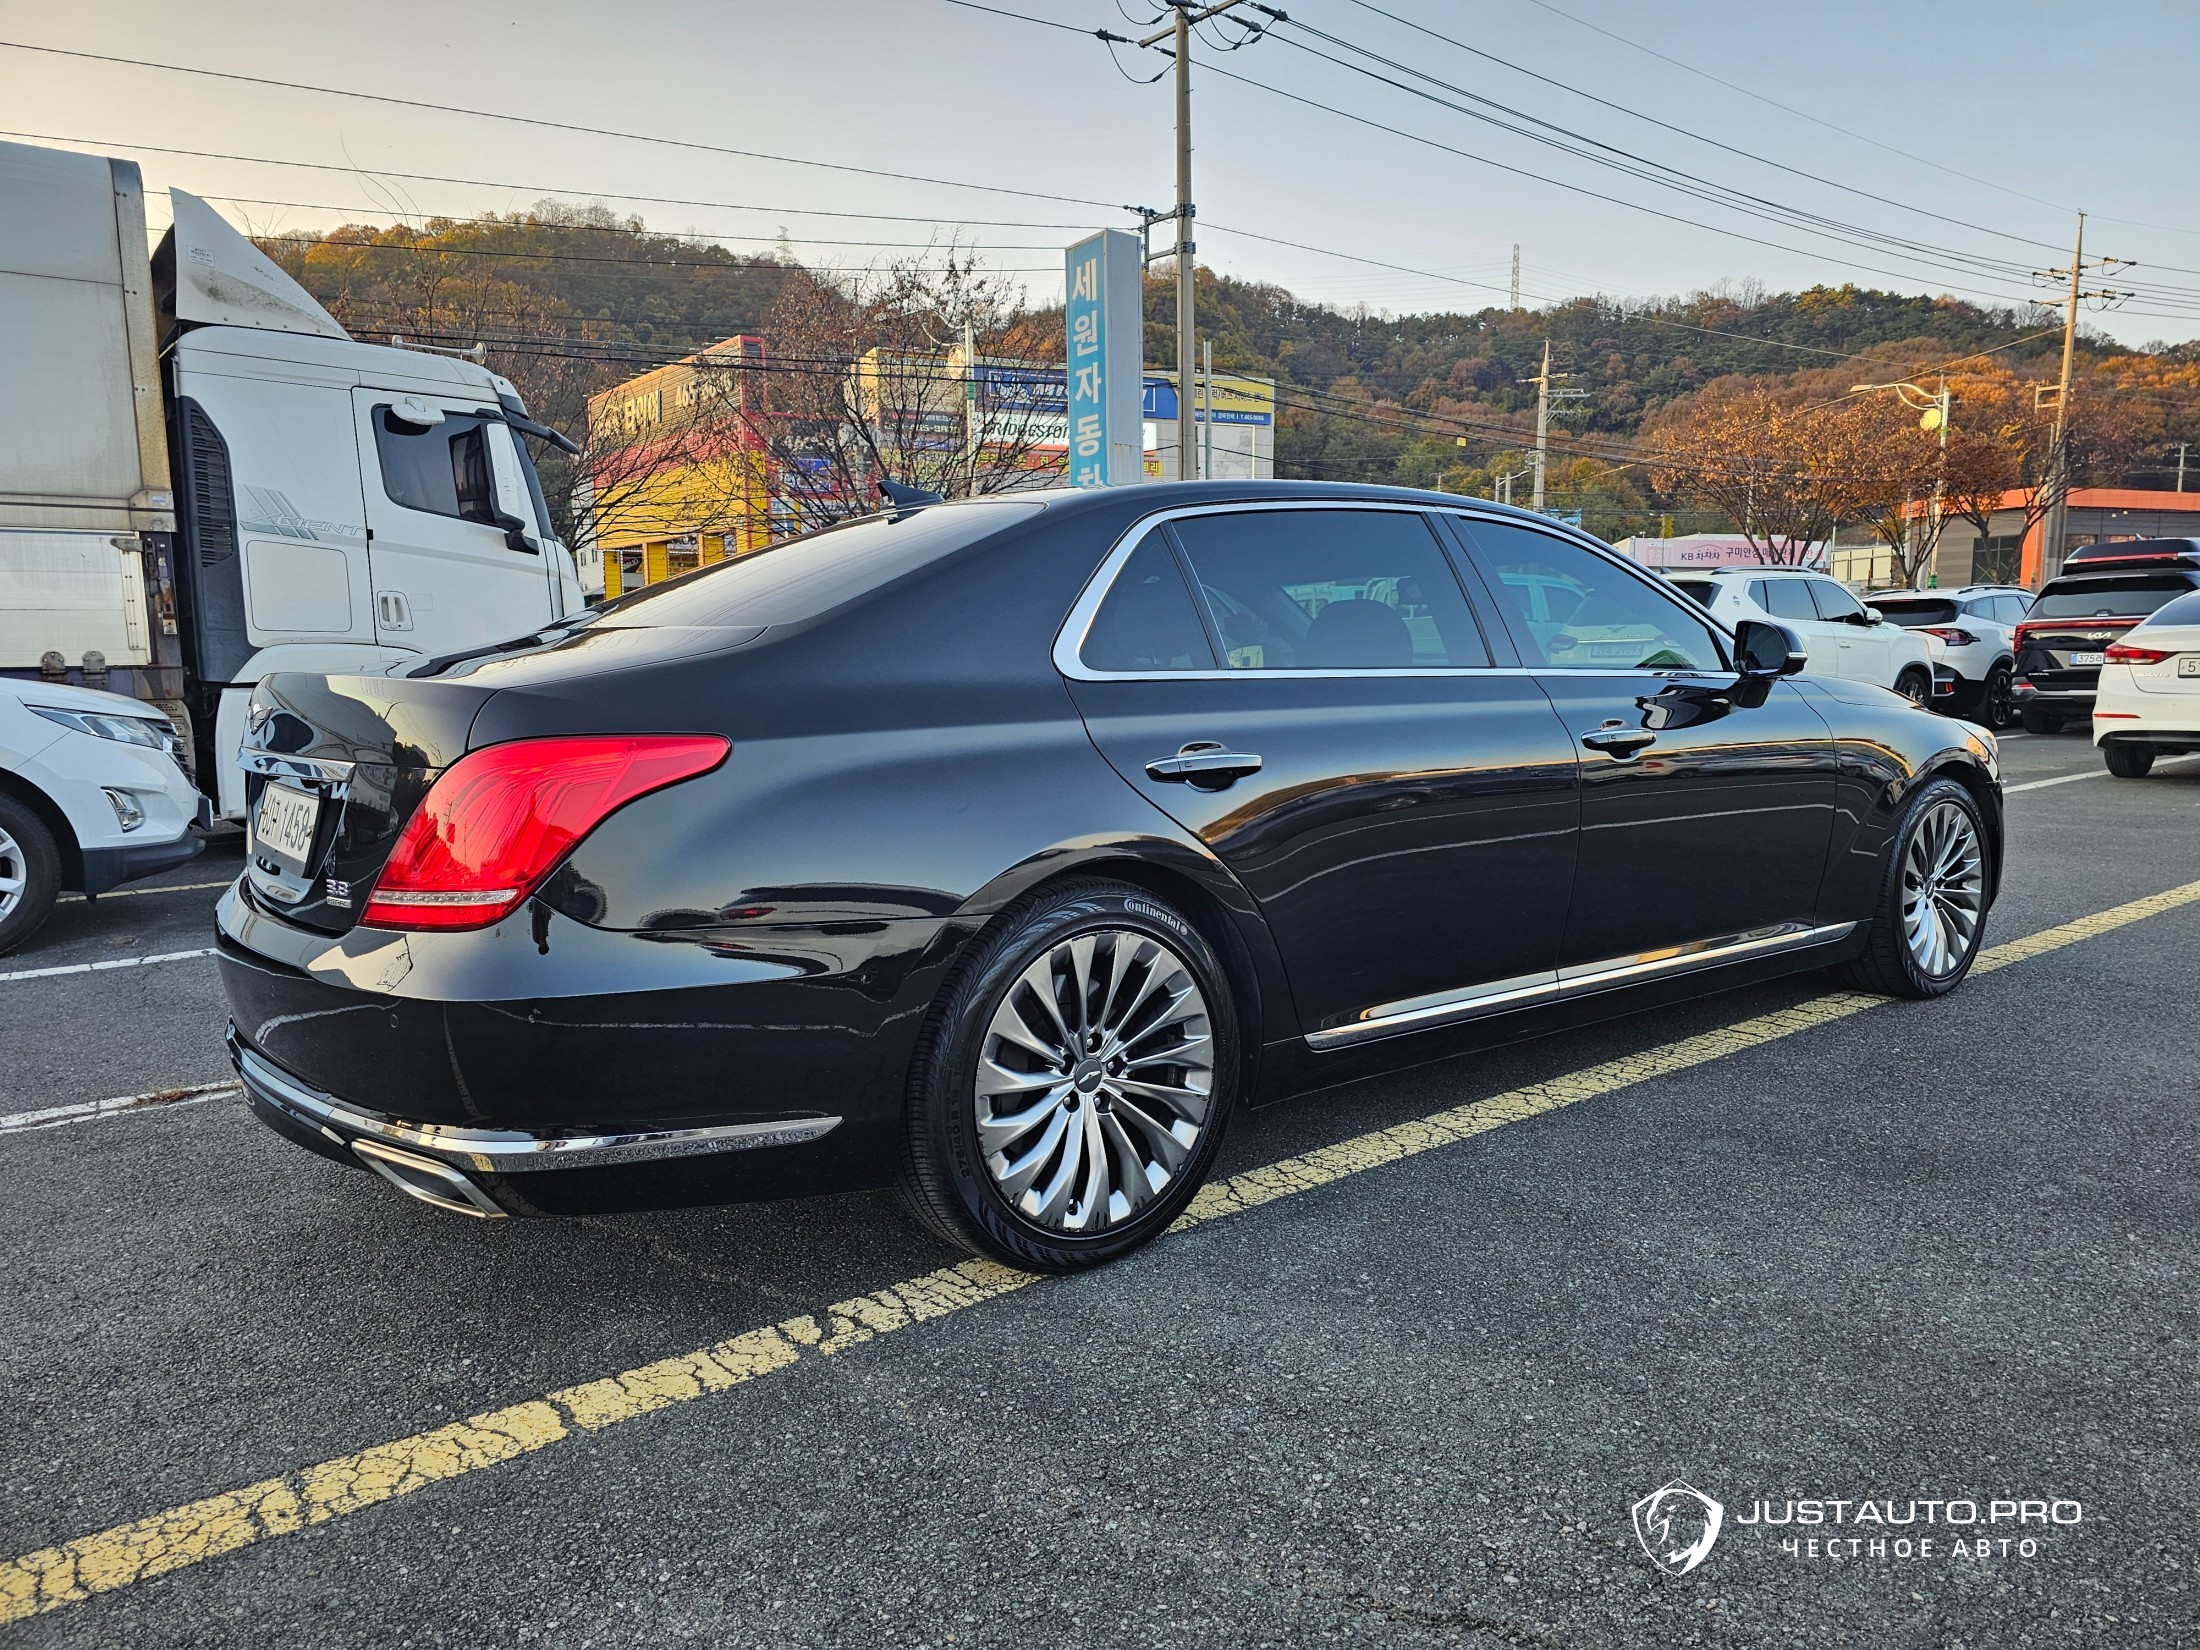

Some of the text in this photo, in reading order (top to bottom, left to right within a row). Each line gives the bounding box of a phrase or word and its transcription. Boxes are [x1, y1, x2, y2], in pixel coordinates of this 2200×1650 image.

[240, 508, 366, 536] XCIENT
[1681, 553, 1694, 561] KB
[1695, 549, 1720, 561] 차차차
[2087, 631, 2112, 640] KIA
[279, 800, 311, 852] 1458
[1123, 898, 1181, 931] Continental
